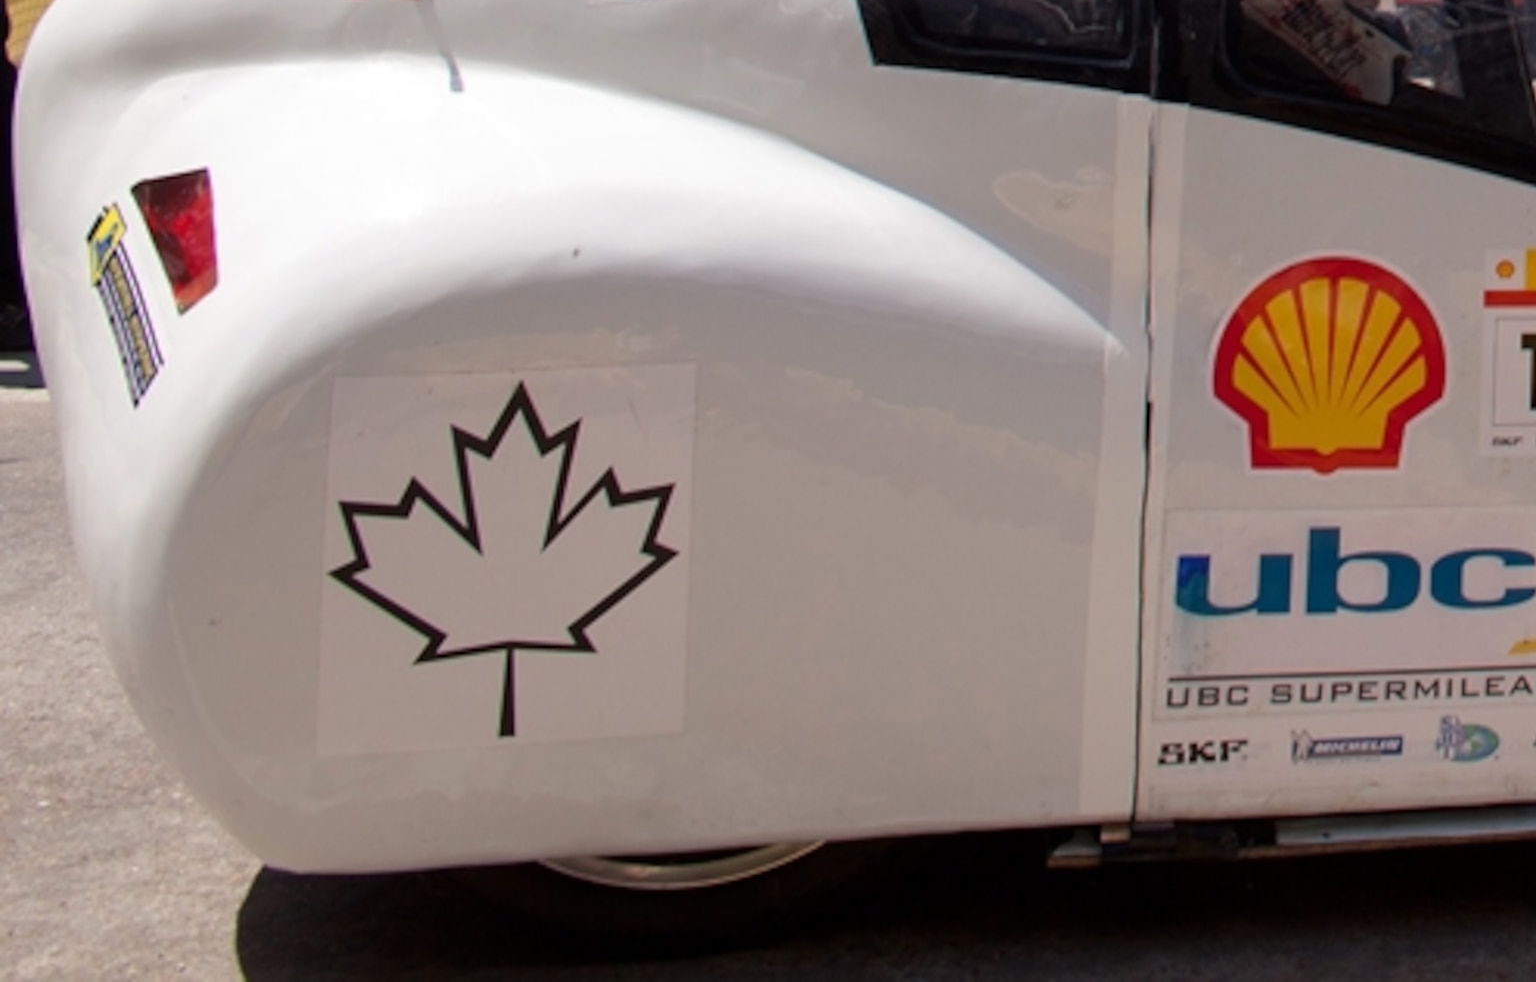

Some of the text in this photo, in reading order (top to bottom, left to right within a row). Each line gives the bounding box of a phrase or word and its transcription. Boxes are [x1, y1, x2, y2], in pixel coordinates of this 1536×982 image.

[1166, 684, 1249, 708] UBC
[1158, 739, 1249, 766] SKF
[1312, 739, 1402, 754] MICHELIN
